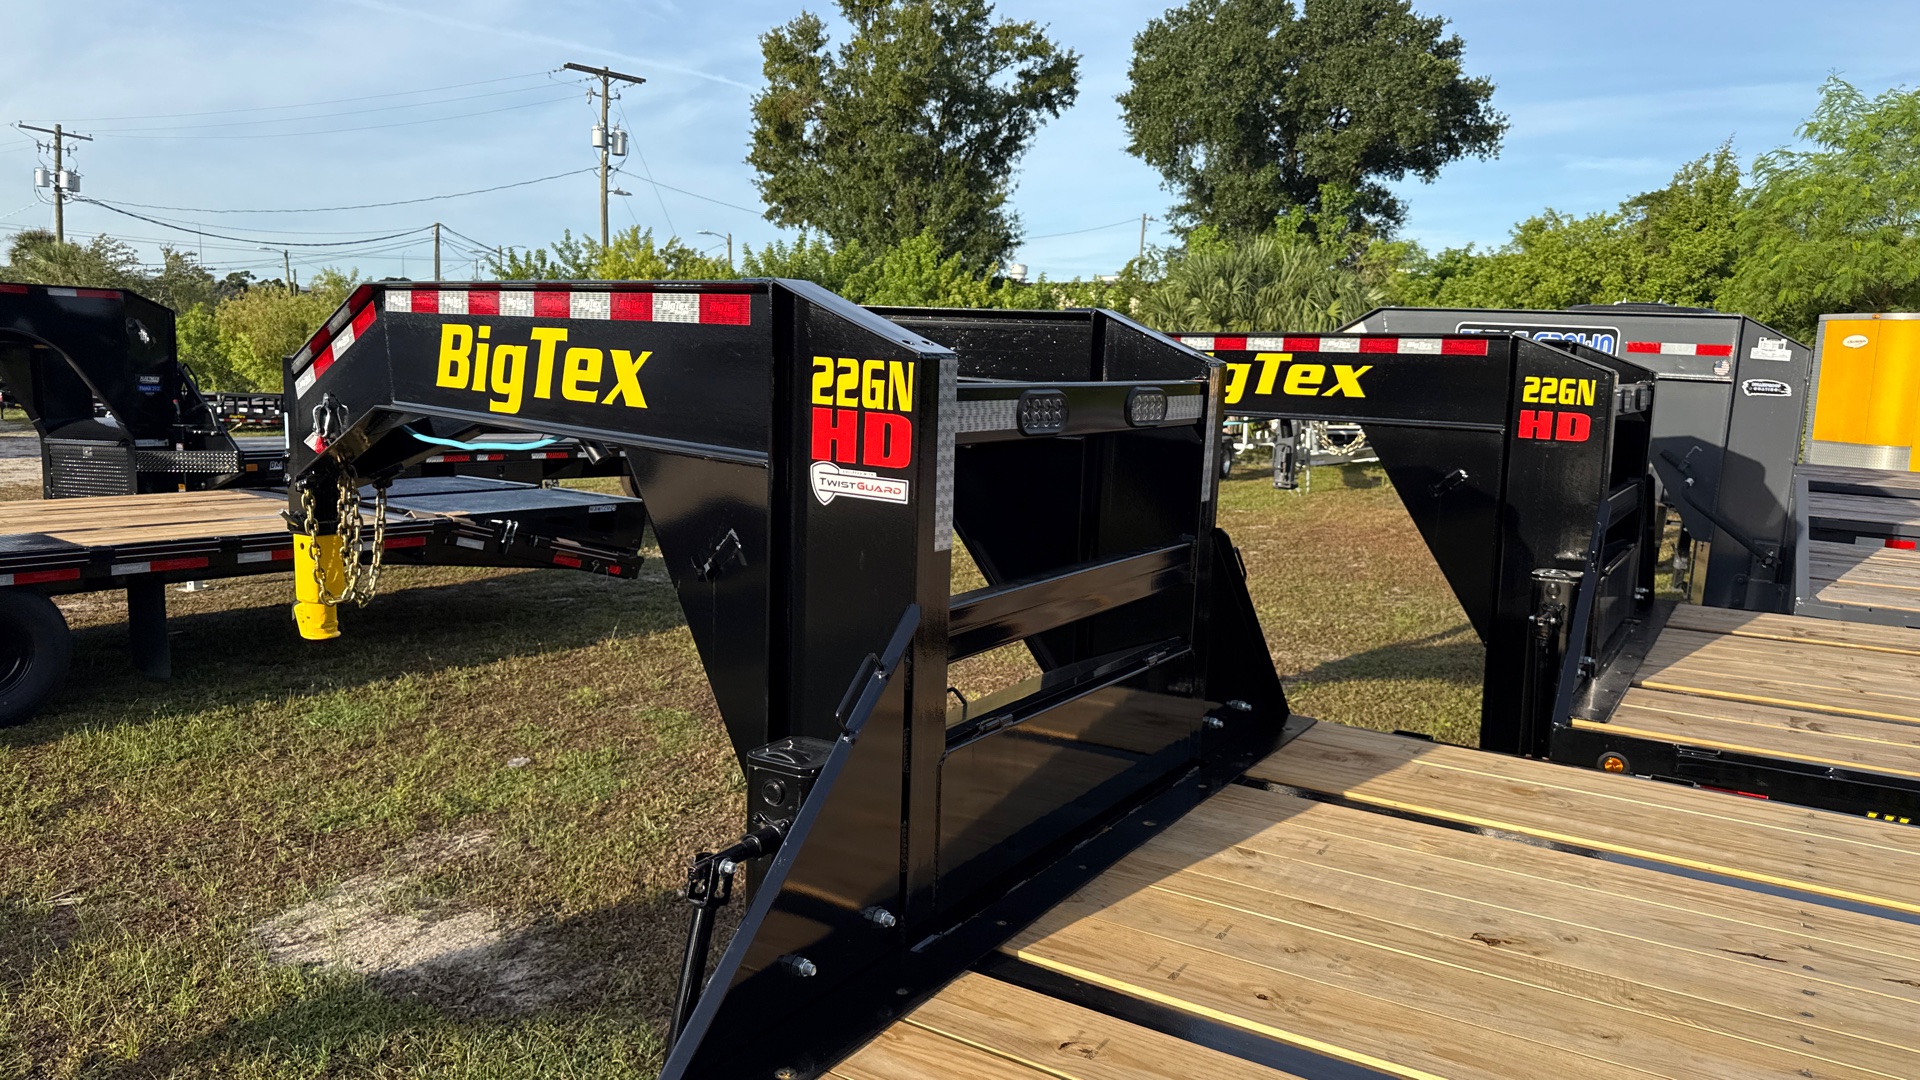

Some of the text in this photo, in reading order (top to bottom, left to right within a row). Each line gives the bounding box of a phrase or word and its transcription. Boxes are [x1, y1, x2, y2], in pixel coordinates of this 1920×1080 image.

[435, 323, 653, 414] BigTex
[811, 356, 915, 412] 22GN
[1205, 351, 1374, 405] gTex
[1522, 376, 1597, 406] 22GN
[811, 407, 913, 469] HD
[1518, 409, 1591, 442] HD
